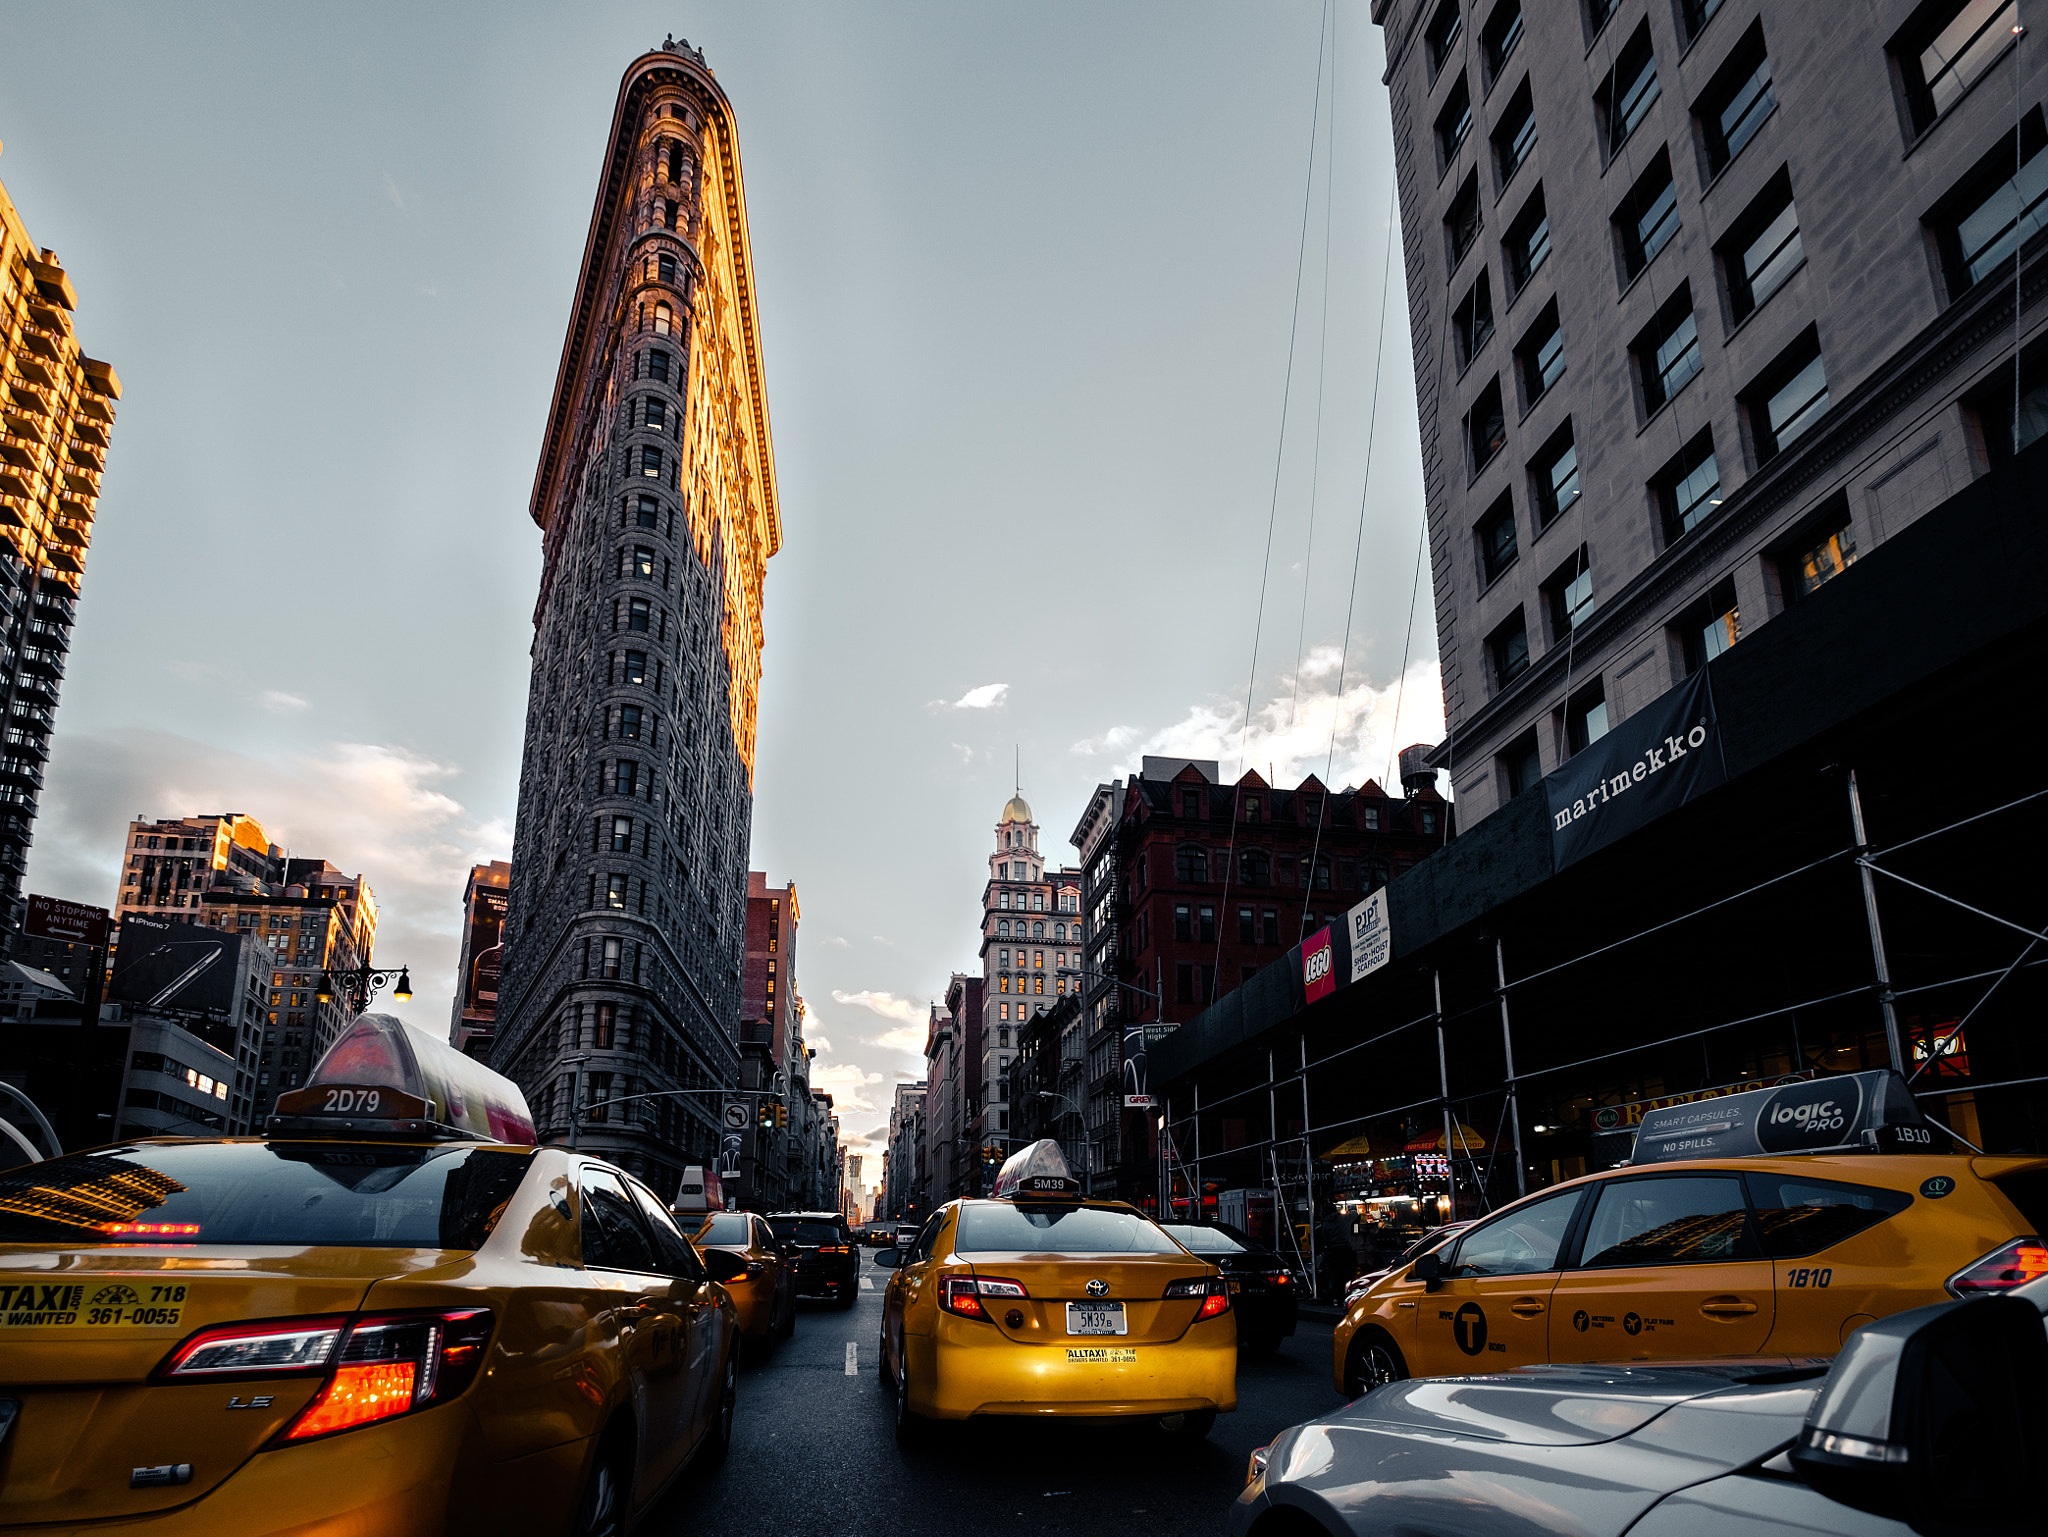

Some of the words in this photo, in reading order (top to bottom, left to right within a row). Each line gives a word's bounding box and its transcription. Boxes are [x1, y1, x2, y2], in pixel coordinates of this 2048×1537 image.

[1554, 725, 1706, 831] marimekko
[35, 901, 50, 911] NO
[54, 904, 102, 921] STOPPING
[46, 914, 89, 929] ANYTIME
[136, 918, 163, 928] iPhone
[1305, 947, 1331, 984] LEGO
[1357, 952, 1385, 974] SCAFFOLD
[323, 1089, 381, 1113] 2D79
[1653, 1116, 1686, 1130] SMART
[1687, 1107, 1742, 1124] CAPSULES.
[1805, 1116, 1845, 1132] PRO
[1895, 1126, 1931, 1144] 1B10
[1662, 1143, 1676, 1152] NO
[1678, 1138, 1716, 1150] SPILLS.
[1034, 1179, 1064, 1189] 5M39
[1788, 1268, 1832, 1288] 1B10
[151, 1286, 186, 1302] 718
[8, 1312, 77, 1325] WANTED
[87, 1308, 180, 1325] 361-0055
[1081, 1312, 1106, 1327] 5M39
[1461, 1313, 1480, 1348] T
[1068, 1349, 1105, 1357] ALLTAXI
[226, 1396, 275, 1410] LE
